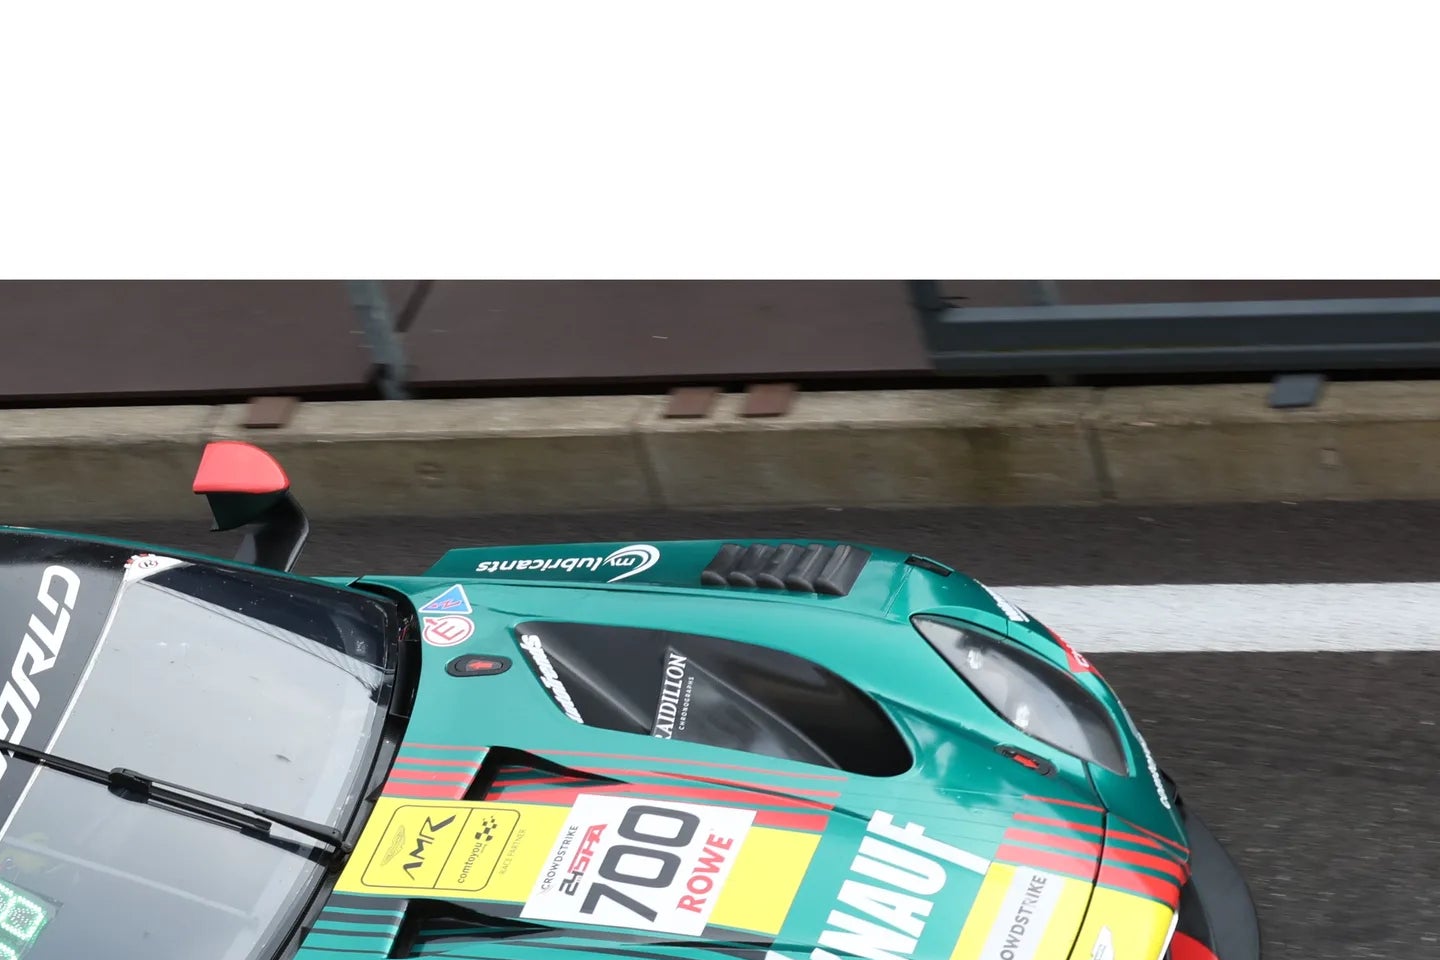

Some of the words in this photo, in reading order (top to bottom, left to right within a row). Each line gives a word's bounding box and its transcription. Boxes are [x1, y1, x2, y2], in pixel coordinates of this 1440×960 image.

[539, 824, 579, 890] CROWDSTRIKE
[578, 804, 701, 923] 700
[676, 832, 733, 914] ROWE
